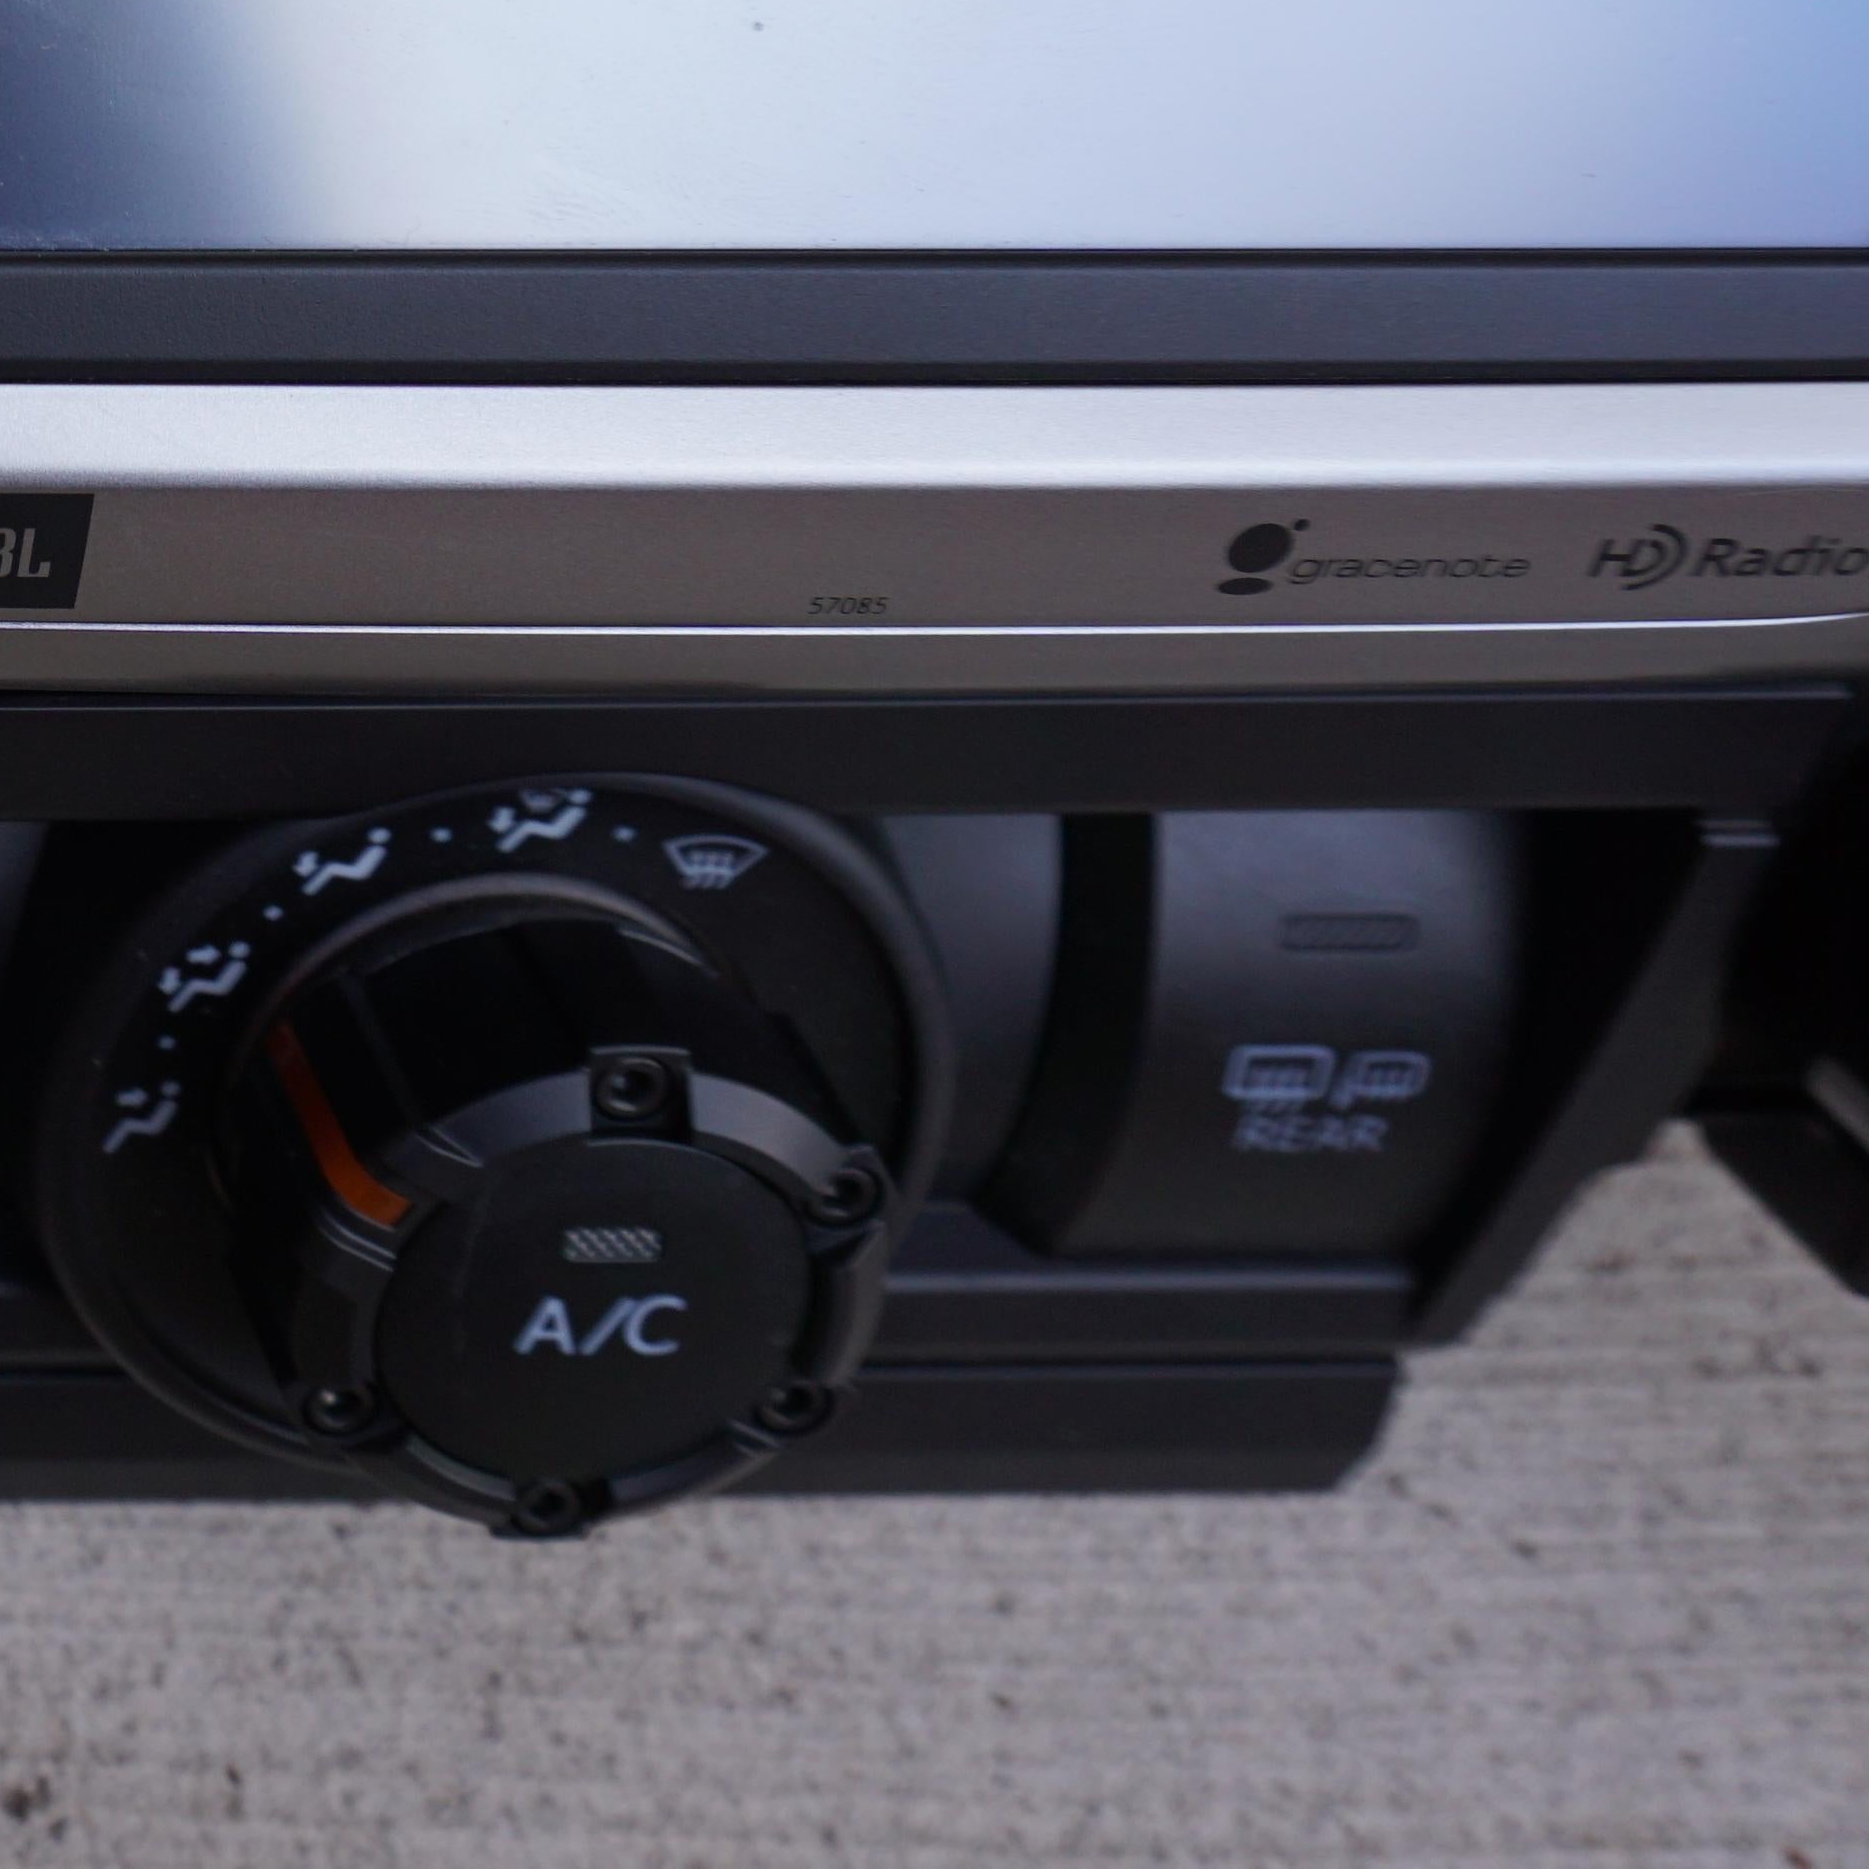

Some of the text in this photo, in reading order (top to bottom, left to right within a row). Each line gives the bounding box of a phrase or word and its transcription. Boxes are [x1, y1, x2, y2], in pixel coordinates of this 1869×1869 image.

[1288, 556, 1531, 586] gracenote
[1586, 523, 1869, 591] HD Radio
[808, 596, 888, 614] 57085
[1234, 1113, 1388, 1152] REAR
[514, 1294, 687, 1356] A/C
